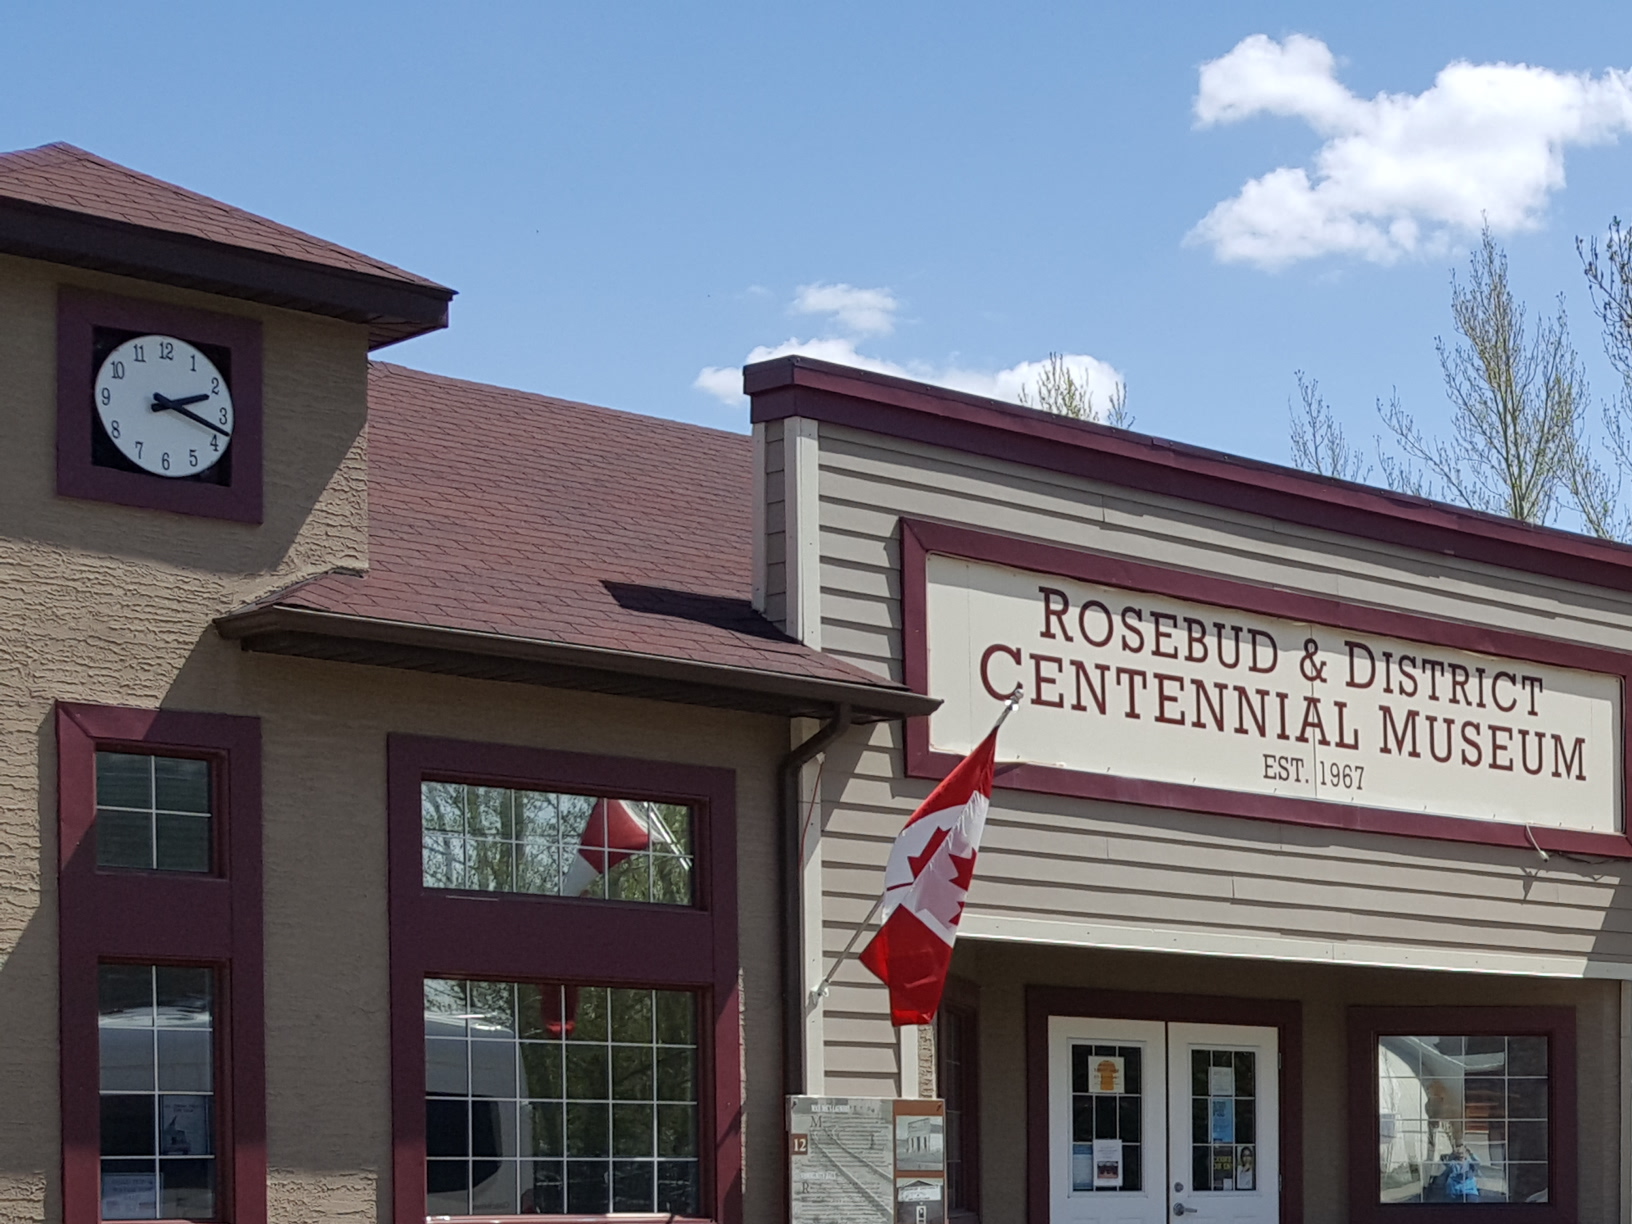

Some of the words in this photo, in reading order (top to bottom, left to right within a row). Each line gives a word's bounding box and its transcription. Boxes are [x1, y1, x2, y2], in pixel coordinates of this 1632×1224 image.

[133, 343, 147, 363] 11
[159, 341, 174, 361] 12
[111, 360, 125, 380] 10
[190, 354, 197, 372] 1
[211, 377, 220, 395] 2
[101, 387, 111, 406] 9
[219, 407, 228, 425] 3
[111, 420, 121, 439] 8
[135, 441, 144, 460] 7
[209, 434, 219, 452] 4
[161, 452, 170, 471] 6
[189, 449, 198, 467] 5
[1038, 586, 1278, 674] ROSEBUD
[1299, 637, 1328, 684] &
[1344, 640, 1543, 717] DISTRICT
[980, 643, 1359, 751] CENTENNIAL
[1378, 704, 1587, 782] MUSEUM
[1262, 753, 1309, 784] EST.
[1319, 760, 1365, 791] 1967
[793, 1138, 807, 1152] 12
